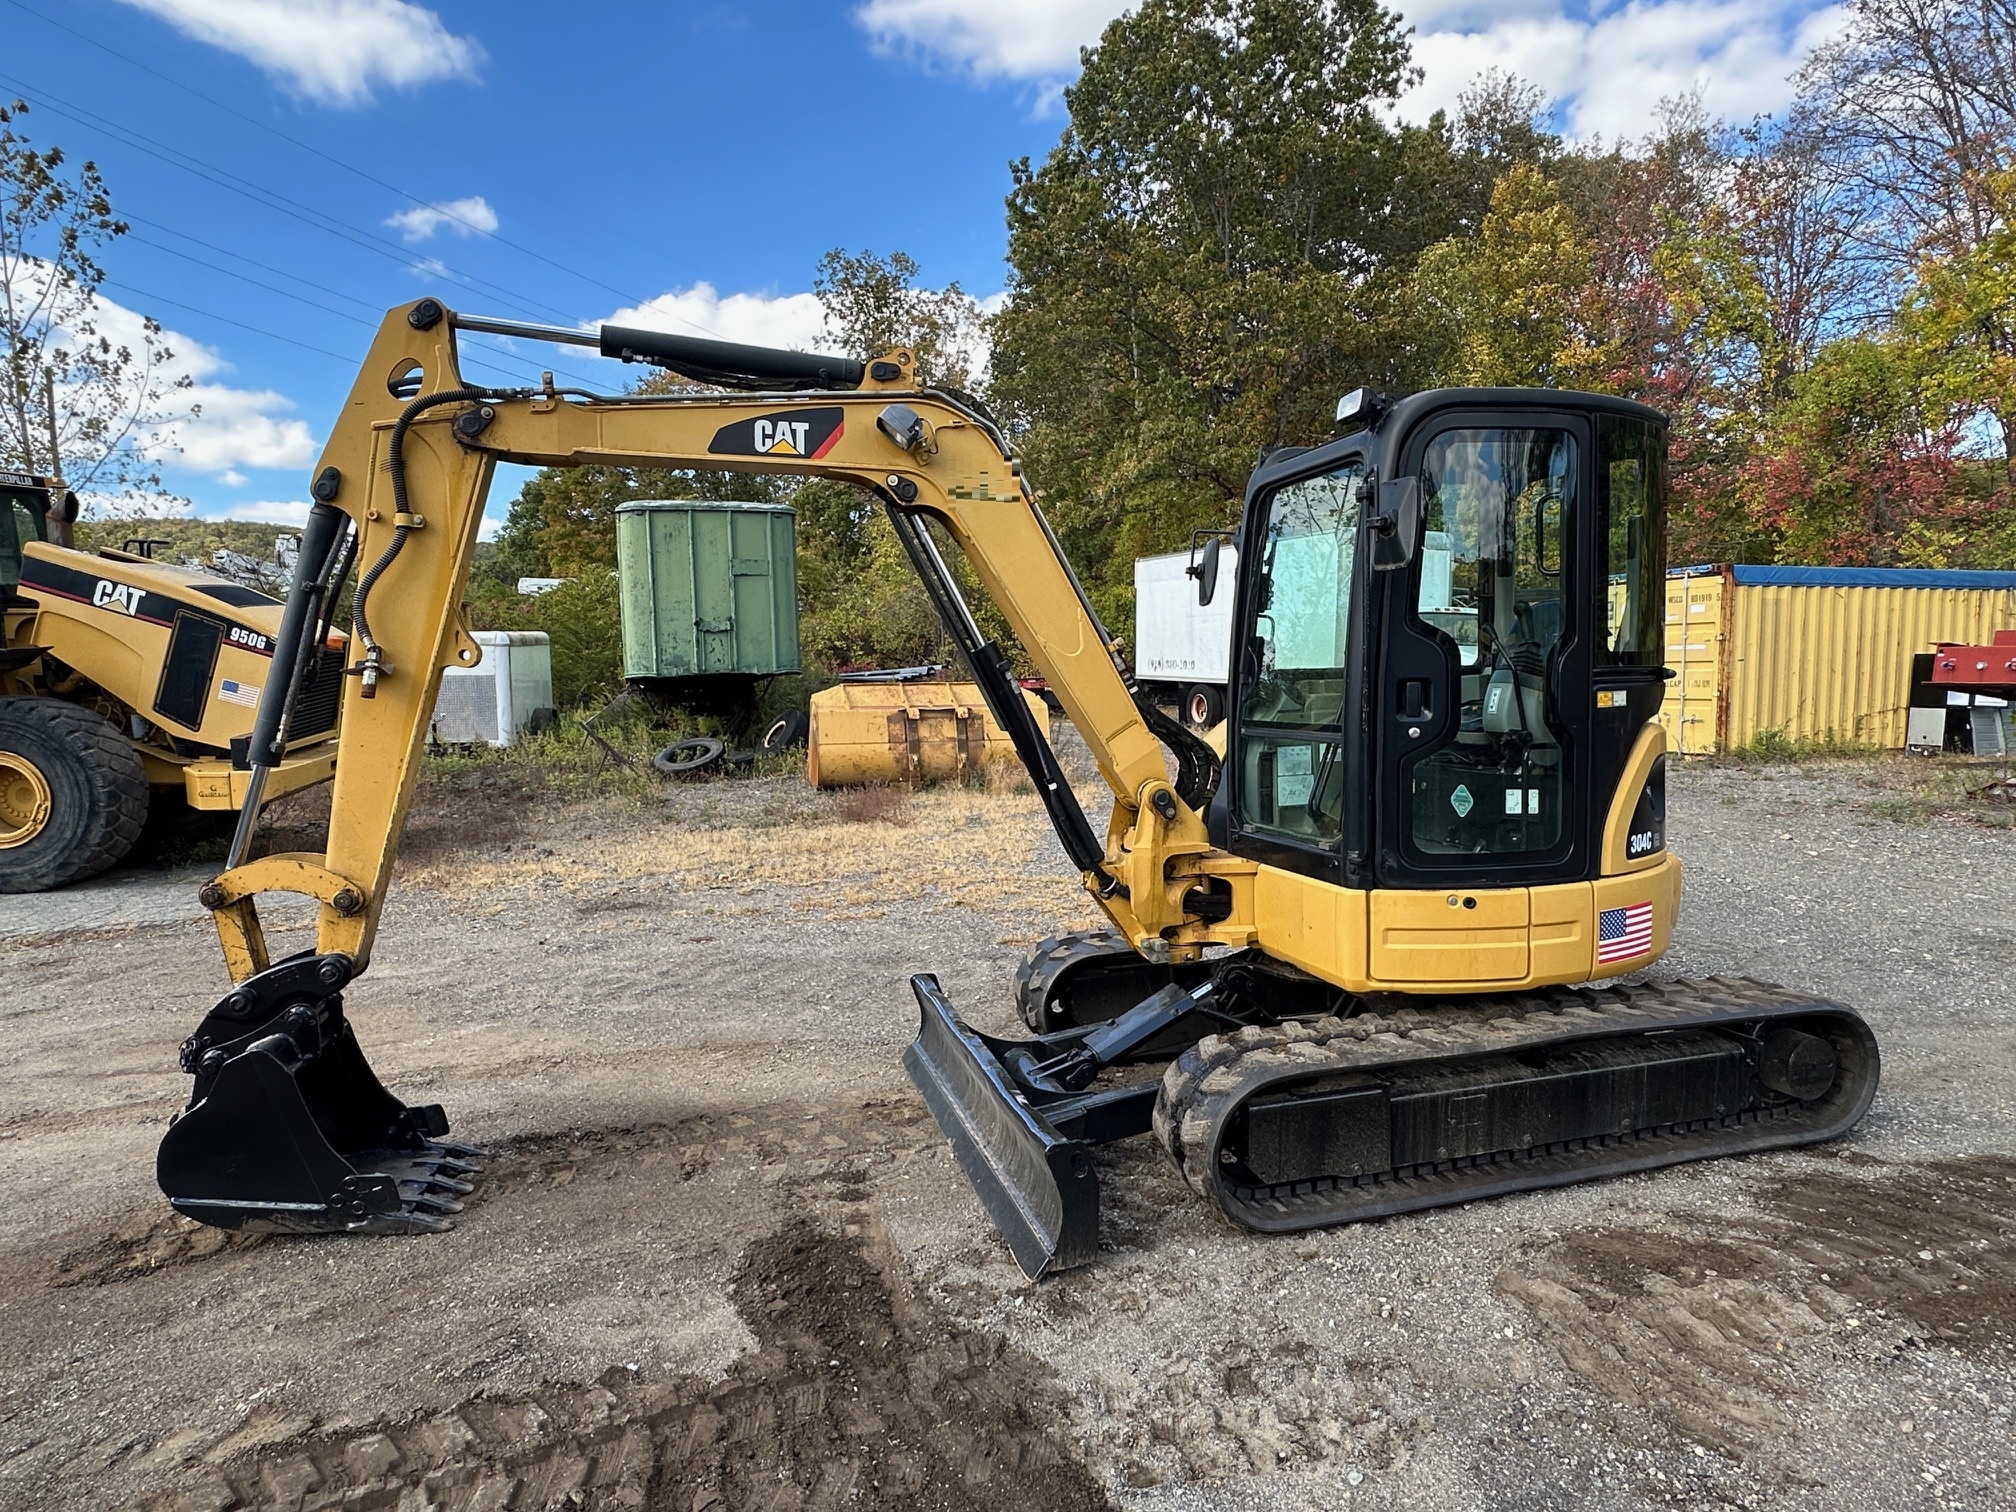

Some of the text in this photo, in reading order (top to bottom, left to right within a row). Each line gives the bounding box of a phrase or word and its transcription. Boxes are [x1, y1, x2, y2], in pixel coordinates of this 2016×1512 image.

[754, 419, 810, 455] CAT
[92, 579, 147, 617] CAT
[229, 627, 267, 650] 950G
[1630, 830, 1652, 854] 304C
